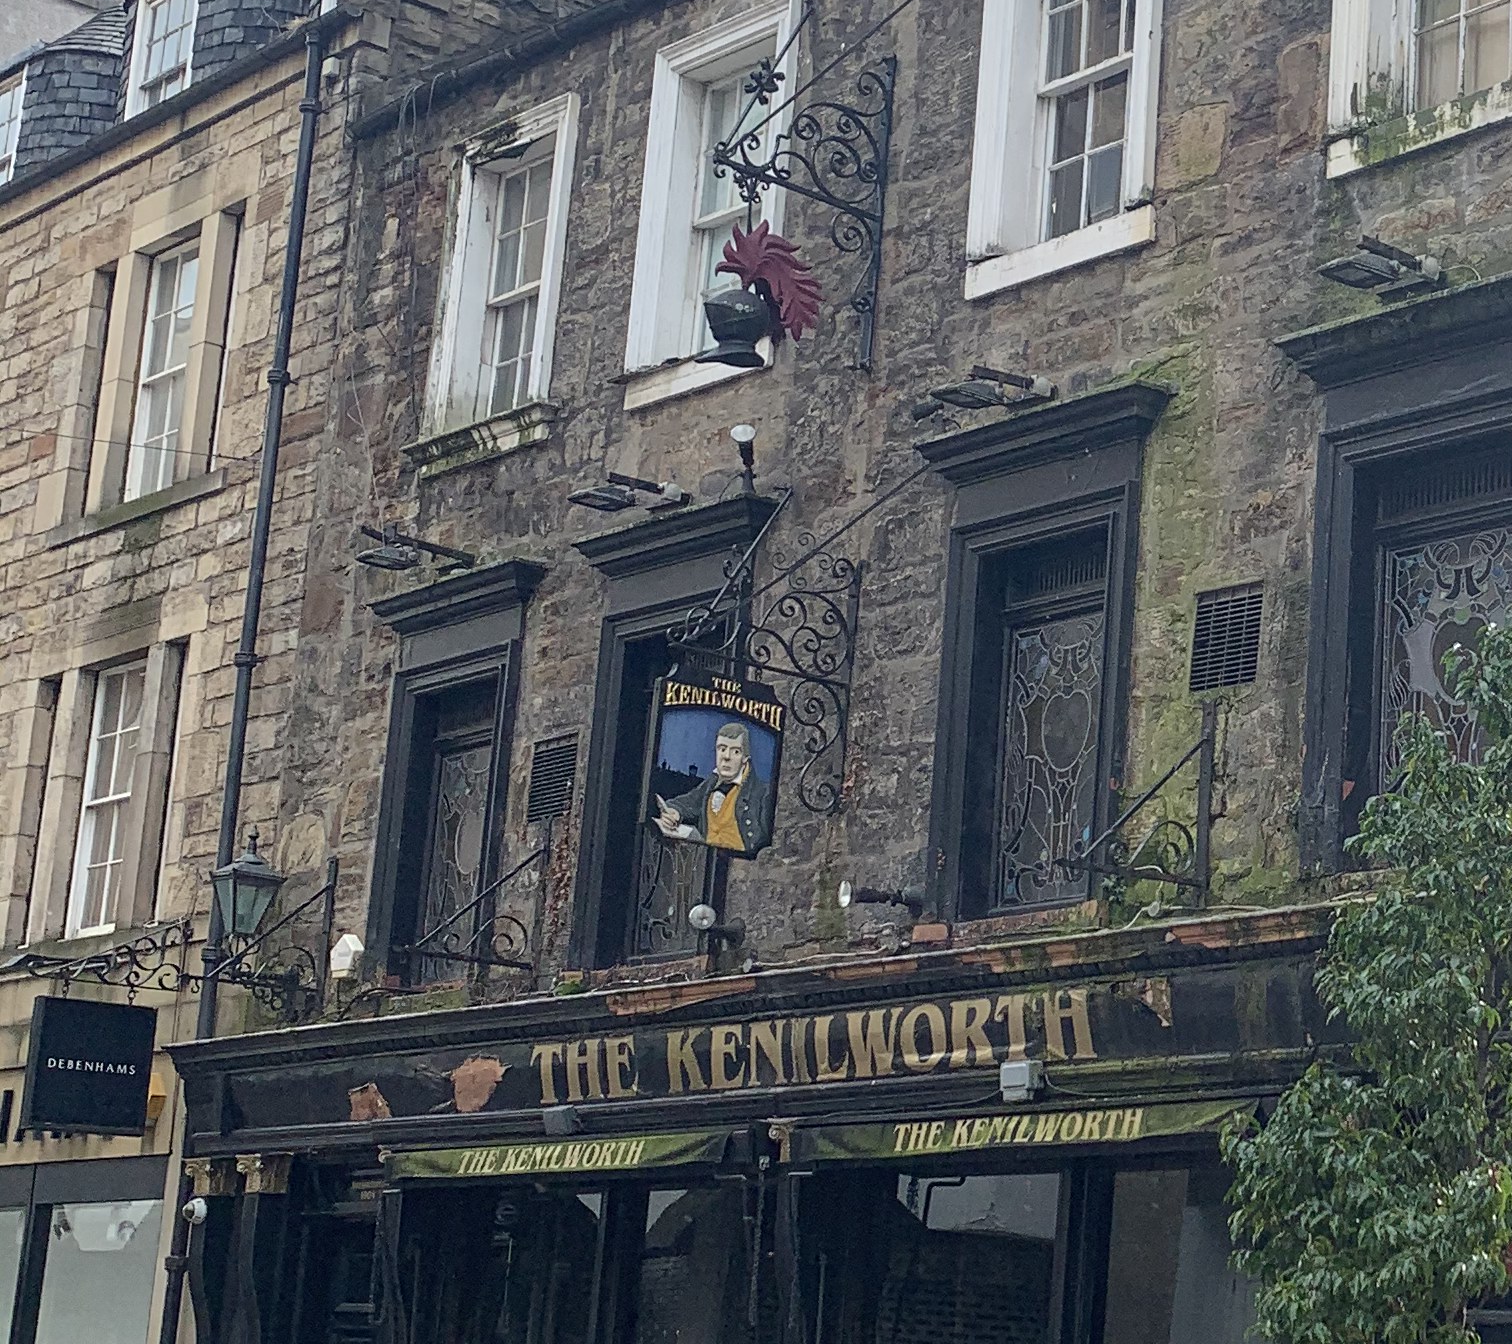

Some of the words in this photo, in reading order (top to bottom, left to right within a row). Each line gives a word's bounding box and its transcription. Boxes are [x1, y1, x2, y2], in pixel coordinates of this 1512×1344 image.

[712, 676, 742, 694] THE
[664, 681, 784, 732] KENILWORTH
[47, 1057, 136, 1075] DEBENHAMS
[531, 1034, 638, 1103] THE
[666, 990, 1097, 1094] KENILWORTH
[893, 1120, 944, 1152] THE
[950, 1108, 1144, 1148] KENILWORTH
[456, 1149, 496, 1174] THE
[500, 1140, 645, 1172] KENILWORTH
